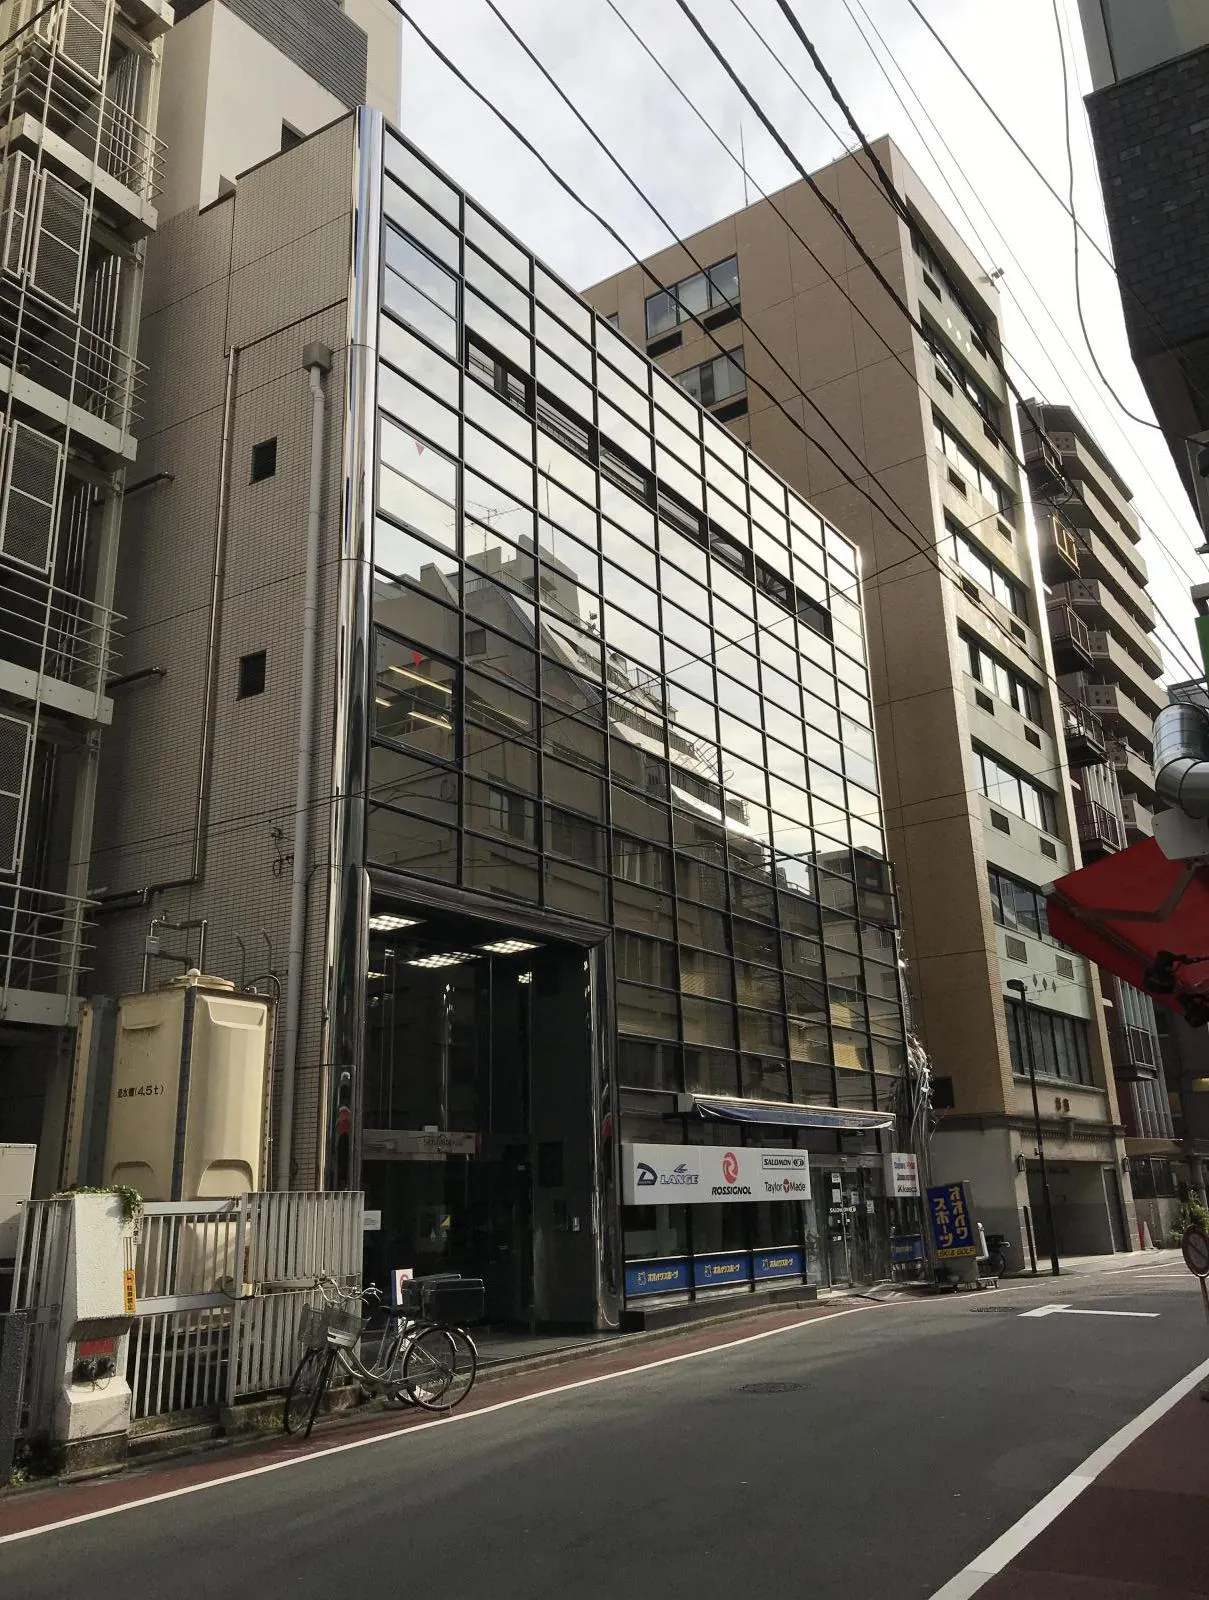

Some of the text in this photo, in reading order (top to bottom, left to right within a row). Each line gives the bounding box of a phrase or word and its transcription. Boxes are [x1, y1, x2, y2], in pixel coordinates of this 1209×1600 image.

[763, 1158, 791, 1166] SALOMON
[660, 1174, 699, 1185] LANGE
[711, 1186, 752, 1196] ROSSIGNOL
[933, 1197, 954, 1248] スポーツ
